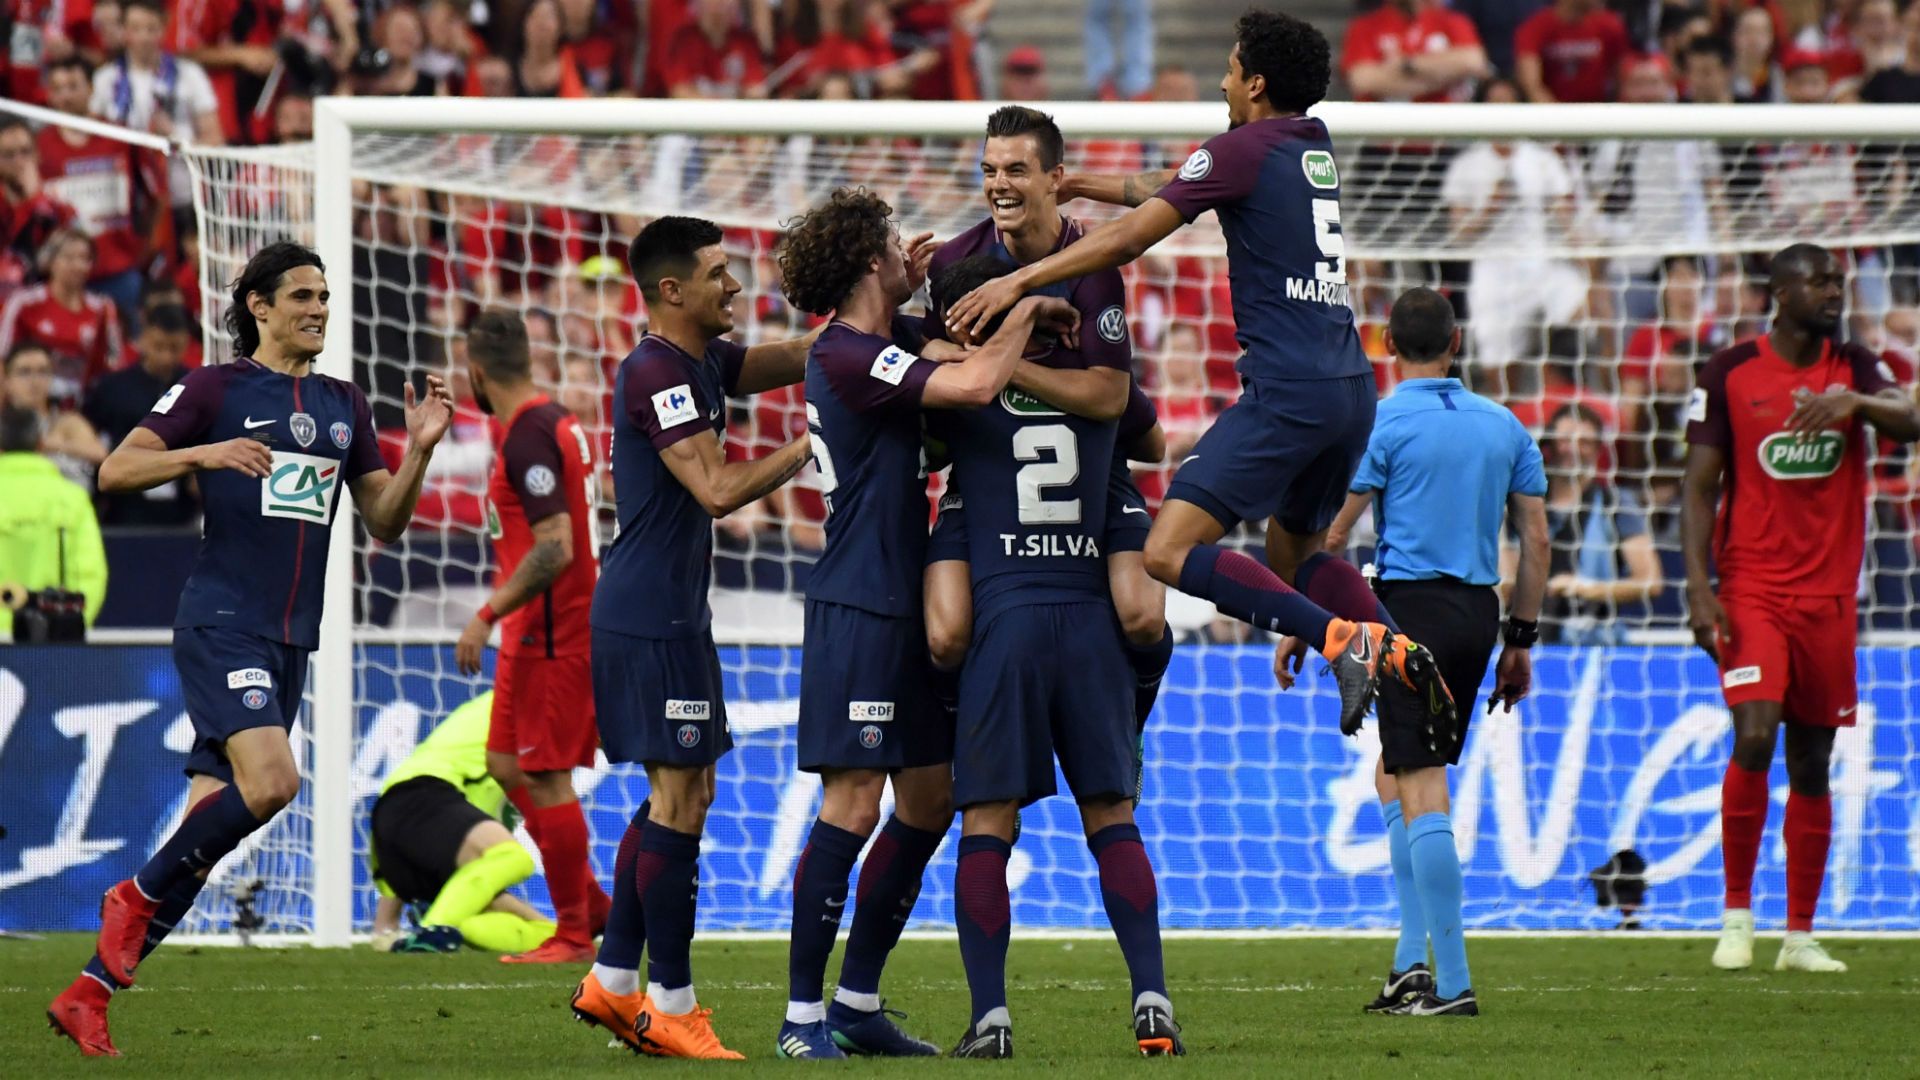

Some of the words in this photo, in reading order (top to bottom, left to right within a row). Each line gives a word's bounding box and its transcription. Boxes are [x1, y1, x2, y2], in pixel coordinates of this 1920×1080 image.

[1312, 198, 1346, 284] 5
[1012, 424, 1081, 525] 2
[1771, 444, 1821, 464] PMU
[1000, 534, 1099, 557] T.SILVA
